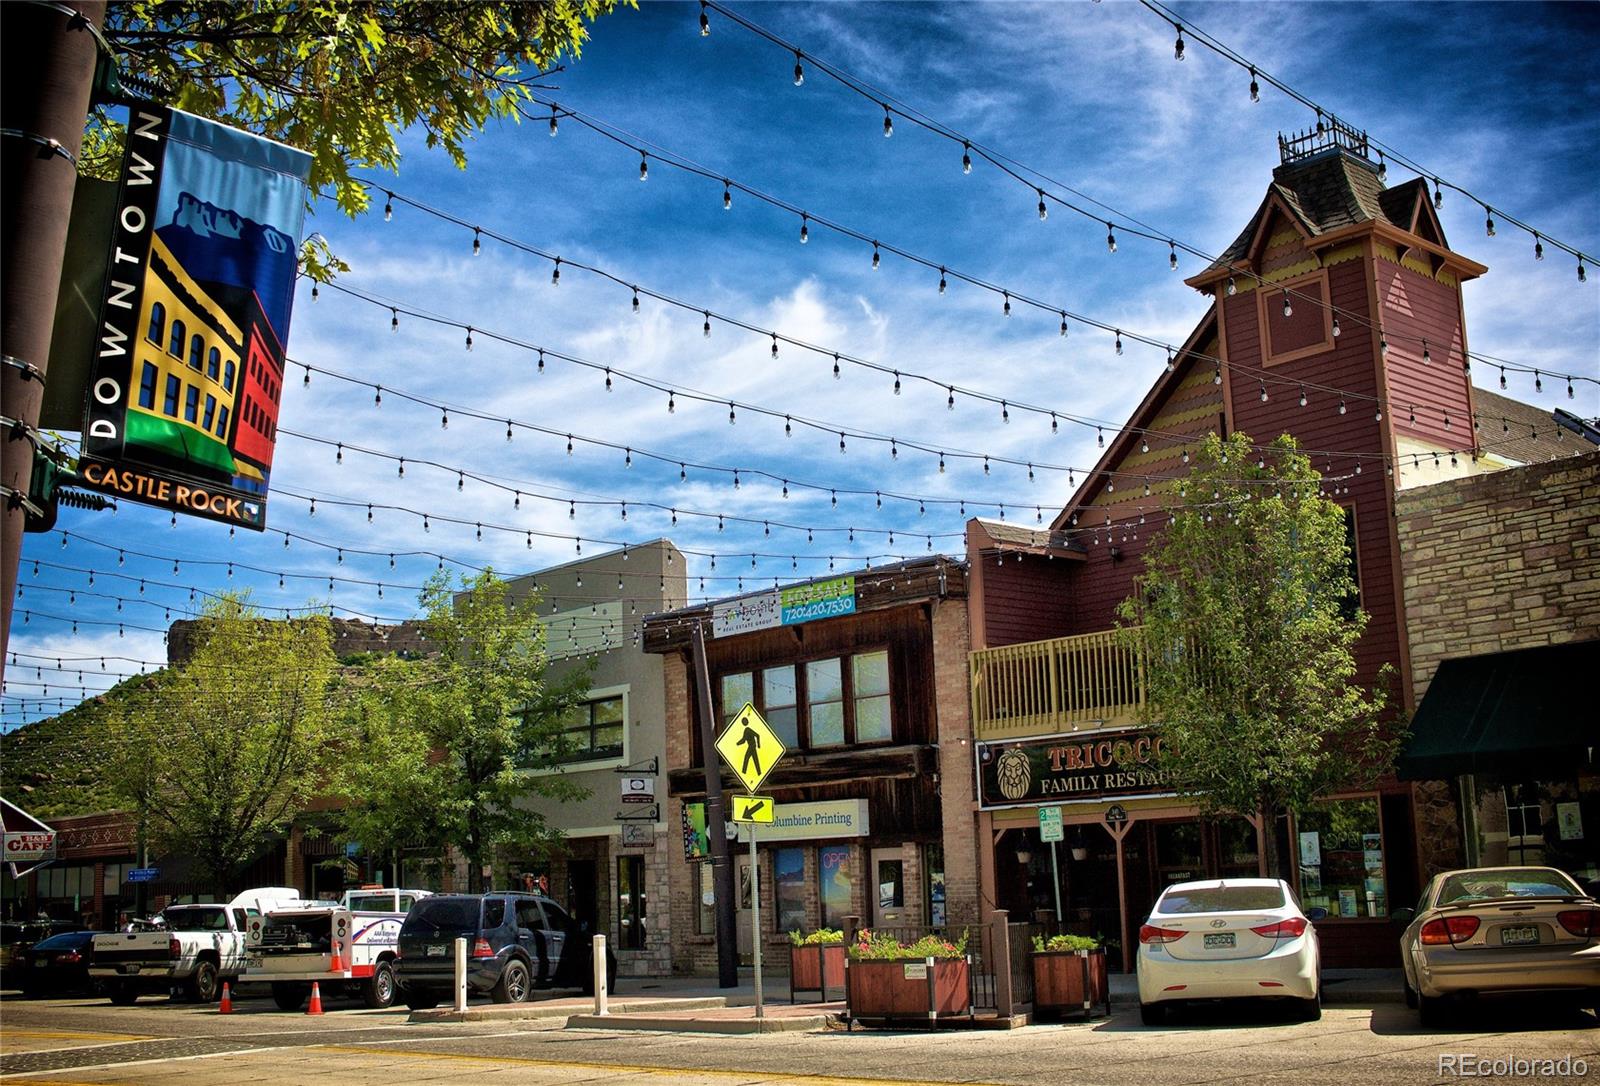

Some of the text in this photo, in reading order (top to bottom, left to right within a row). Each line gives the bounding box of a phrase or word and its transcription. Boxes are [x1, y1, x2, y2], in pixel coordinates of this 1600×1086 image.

[90, 111, 163, 439] DOWNTOWN
[84, 463, 241, 519] CASTLE ROCK
[723, 618, 772, 633] REAL ESTATE GROUP
[1040, 775, 1100, 794] FAMILY
[815, 812, 852, 827] Printing
